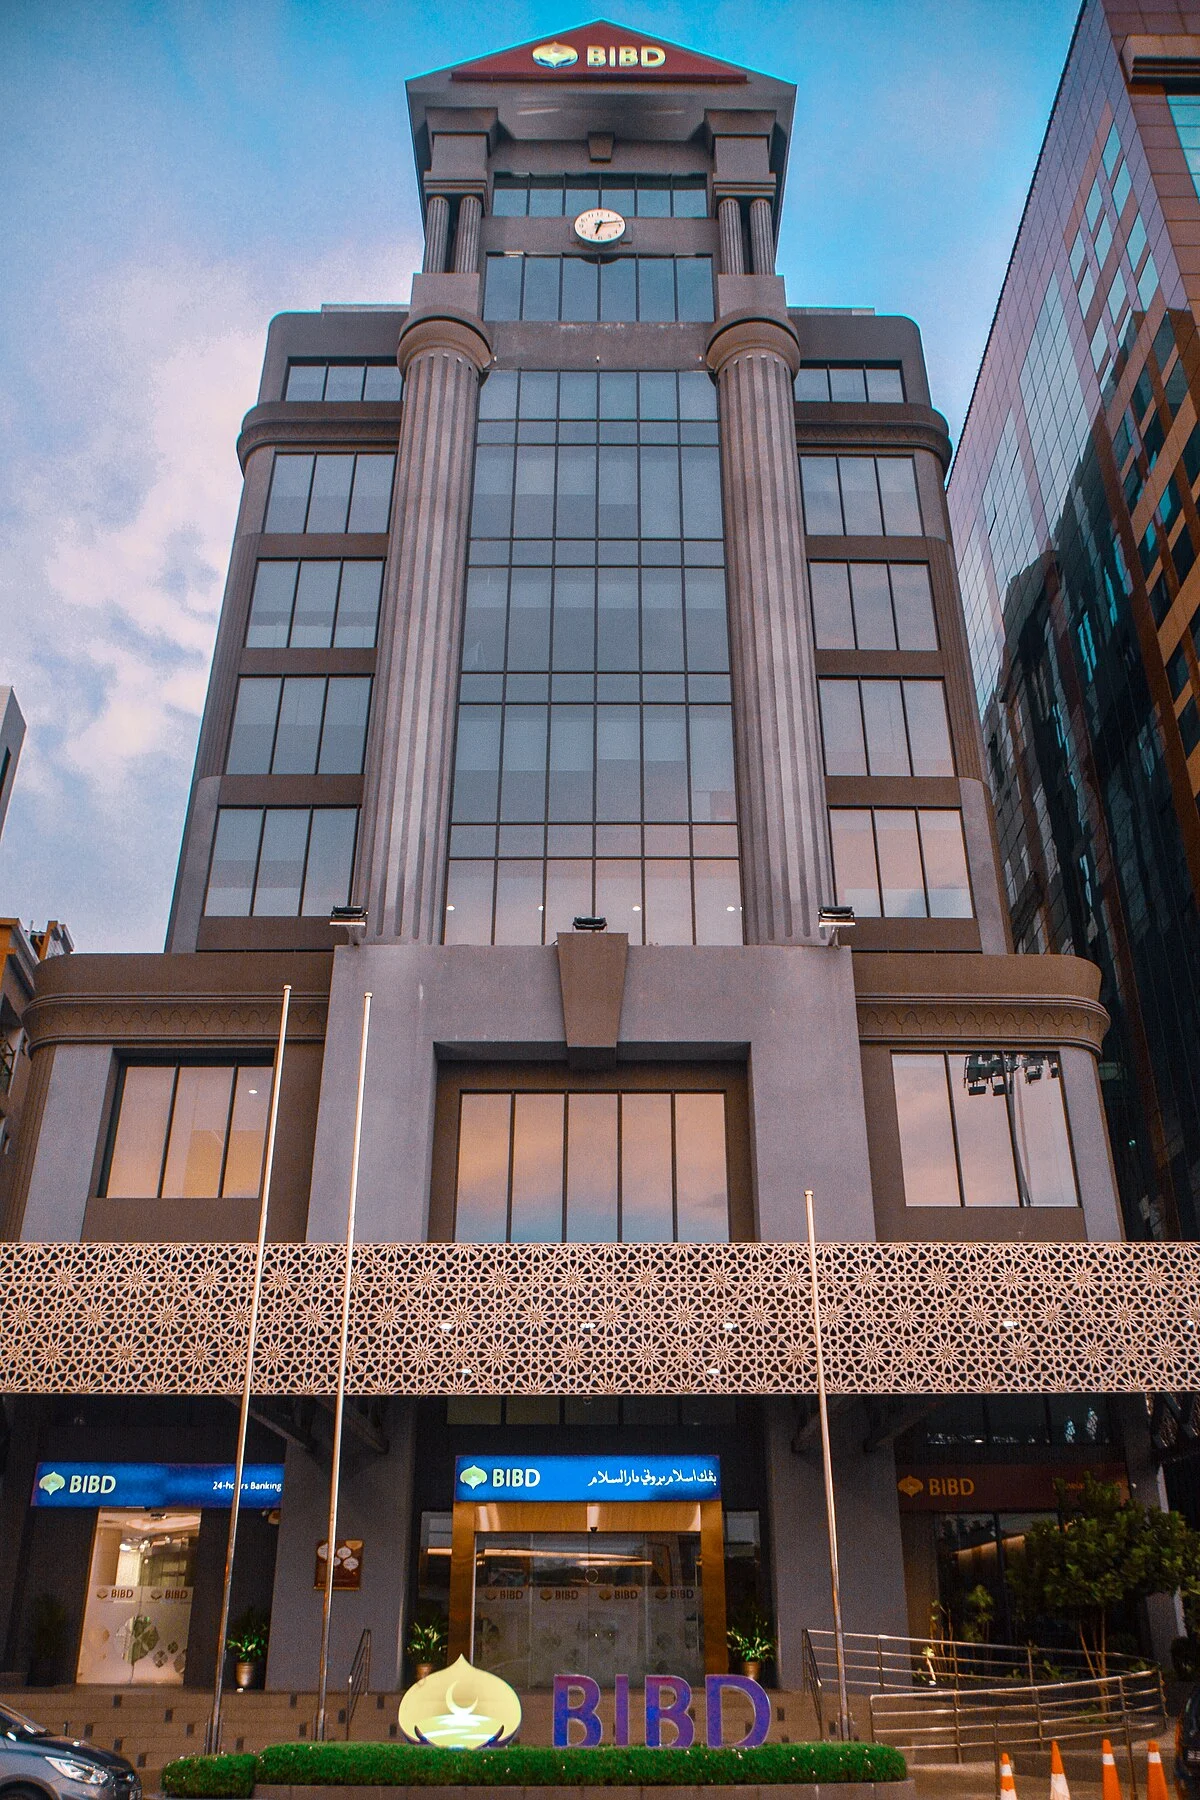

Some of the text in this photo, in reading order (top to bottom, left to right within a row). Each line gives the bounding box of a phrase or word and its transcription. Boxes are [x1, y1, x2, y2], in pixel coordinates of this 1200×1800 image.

[587, 45, 666, 68] BIBD
[492, 1468, 541, 1487] BIBD
[69, 1475, 117, 1494] BIBD
[212, 1481, 282, 1492] 24-hors Banking
[928, 1478, 975, 1496] BIBD
[110, 1589, 134, 1599] BIBD
[164, 1589, 188, 1600] BIBD
[500, 1590, 524, 1600] BIBD
[555, 1590, 579, 1600] BIBD
[614, 1589, 638, 1600] BIBD
[670, 1589, 694, 1600] BIBD
[553, 1674, 772, 1749] BIBD
